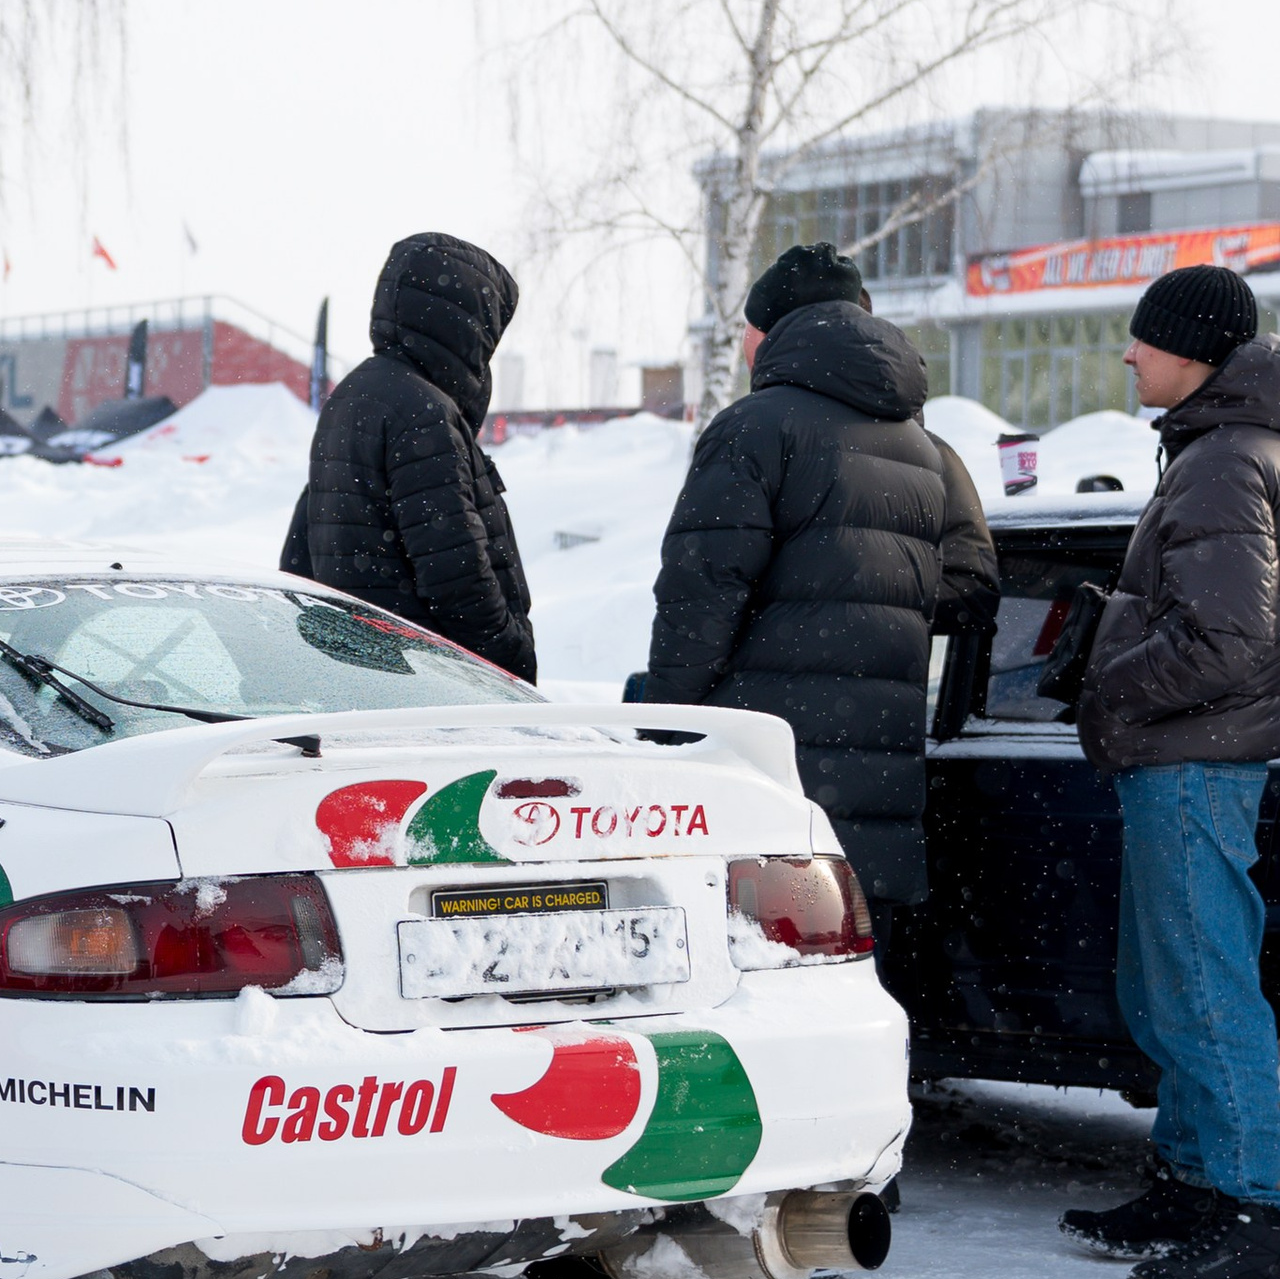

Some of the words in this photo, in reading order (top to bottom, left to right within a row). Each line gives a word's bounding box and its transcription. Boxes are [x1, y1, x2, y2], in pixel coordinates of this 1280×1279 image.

[62, 582, 347, 613] TOYOTA
[570, 804, 709, 840] TOYOTA
[441, 897, 501, 913] WARNING!
[504, 896, 529, 909] CAR
[532, 895, 542, 907] IS
[545, 891, 602, 907] CHARGED.
[241, 1066, 458, 1146] Castrol
